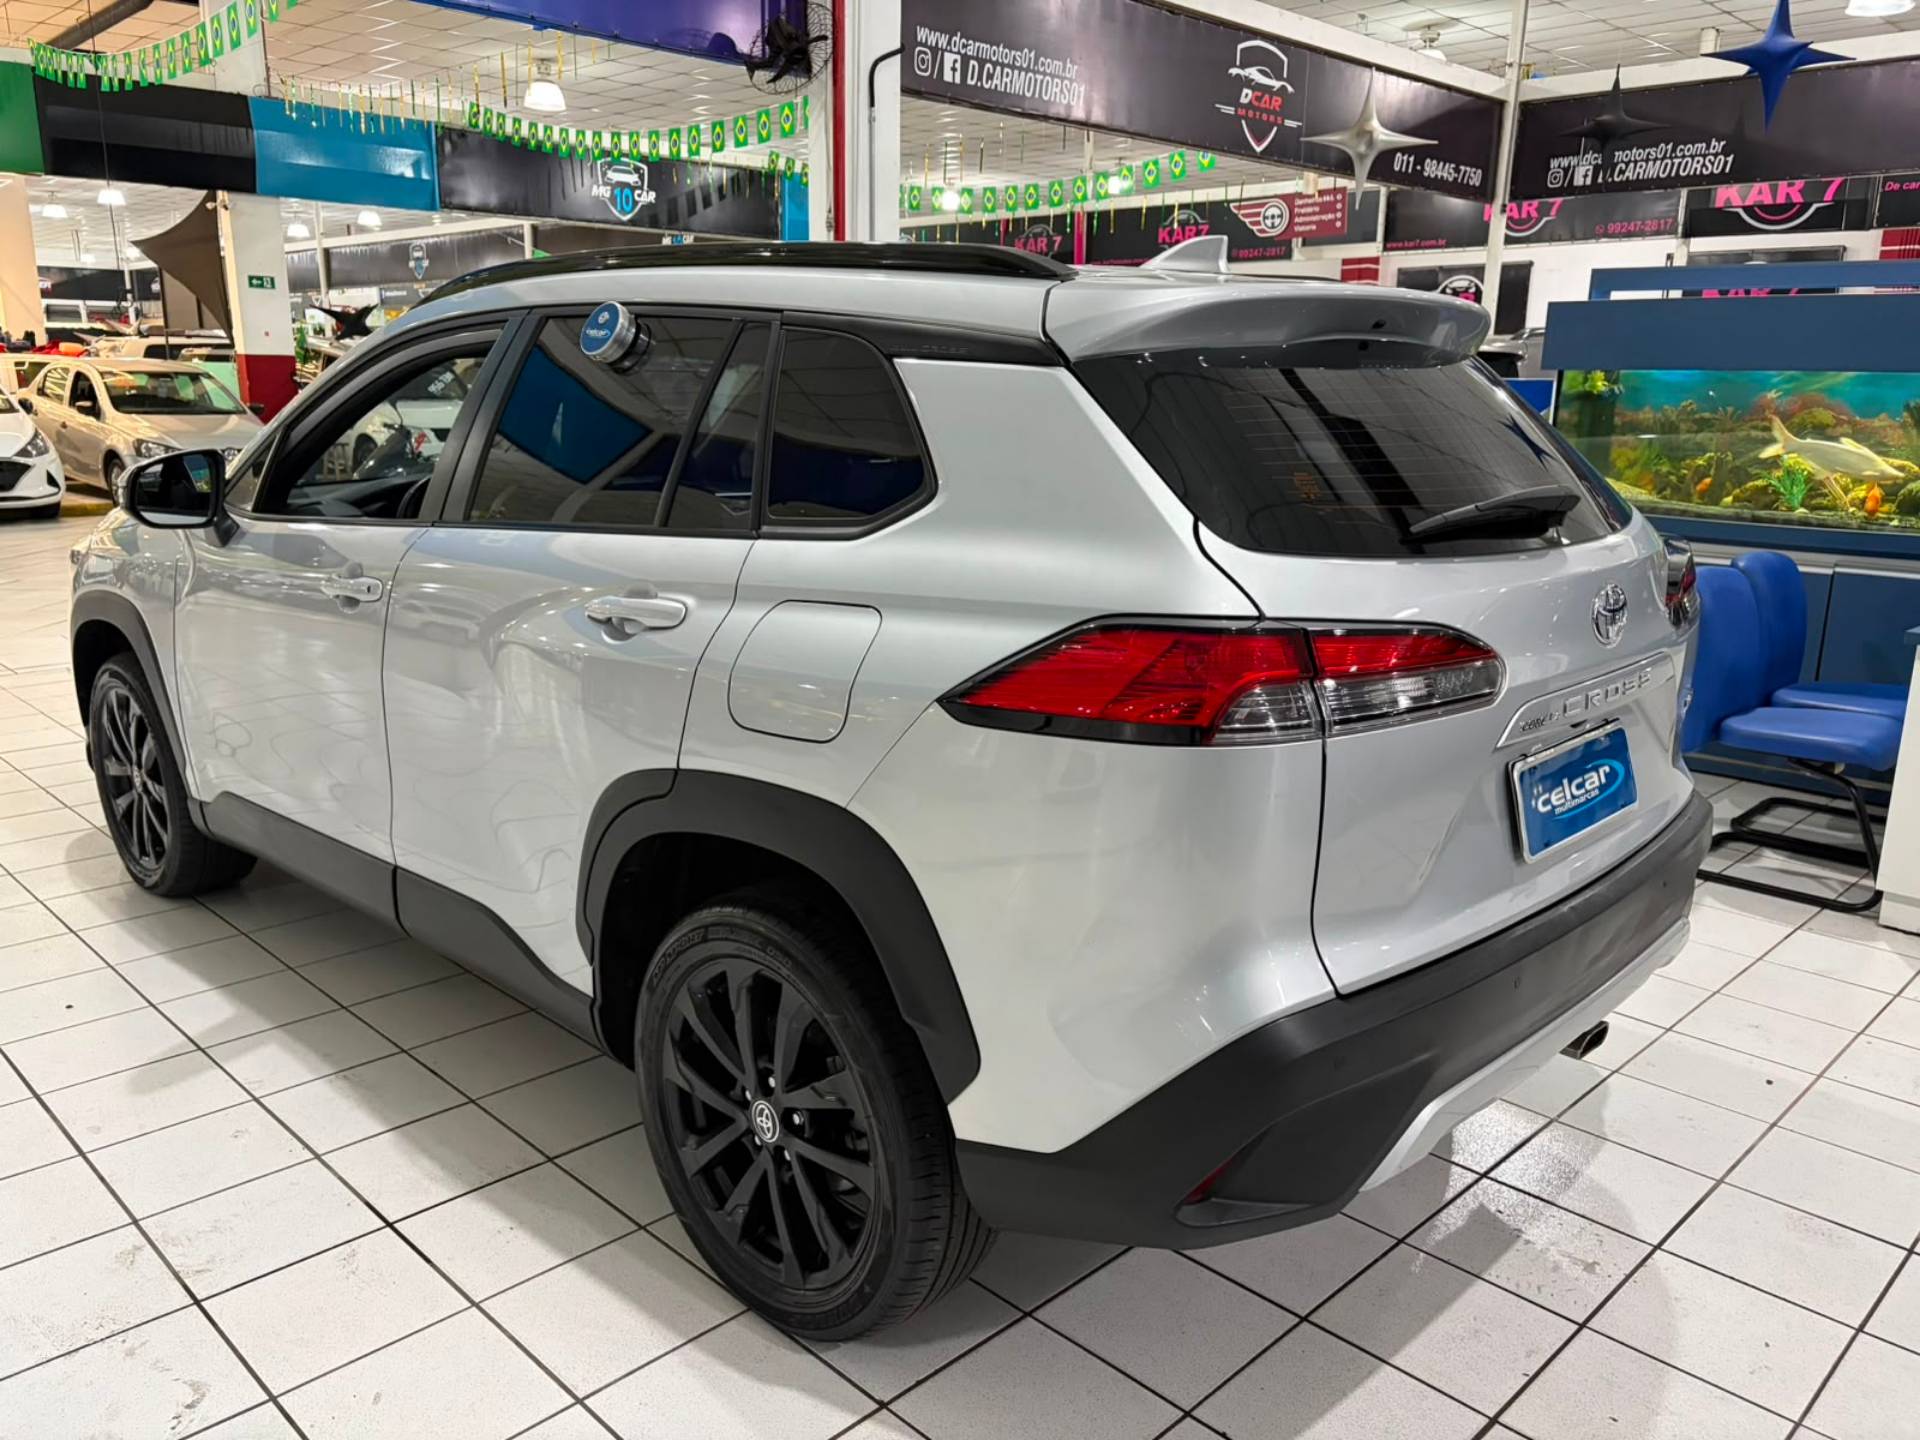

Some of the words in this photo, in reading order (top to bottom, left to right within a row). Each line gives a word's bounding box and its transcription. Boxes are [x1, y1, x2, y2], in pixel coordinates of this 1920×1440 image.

[916, 26, 1078, 80] www.dcarmotors01.com.br
[967, 59, 1086, 107] D.CARMOTORS01
[1240, 87, 1284, 111] DCAR
[1236, 107, 1283, 125] MOTORS
[1393, 152, 1415, 174] 011
[1423, 158, 1482, 187] 98445-7750
[591, 185, 611, 198] MG
[614, 186, 634, 214] 10
[634, 190, 656, 204] CAR
[1715, 180, 1806, 208] KAR
[1823, 177, 1844, 202] 7
[1884, 181, 1900, 192] De
[1607, 218, 1673, 234] 99247-2817
[1014, 236, 1049, 253] KAR
[1053, 235, 1063, 251] 7
[1563, 667, 1652, 718] CROSS
[1537, 765, 1611, 813] celcar
[1554, 788, 1600, 815] multimarcas
